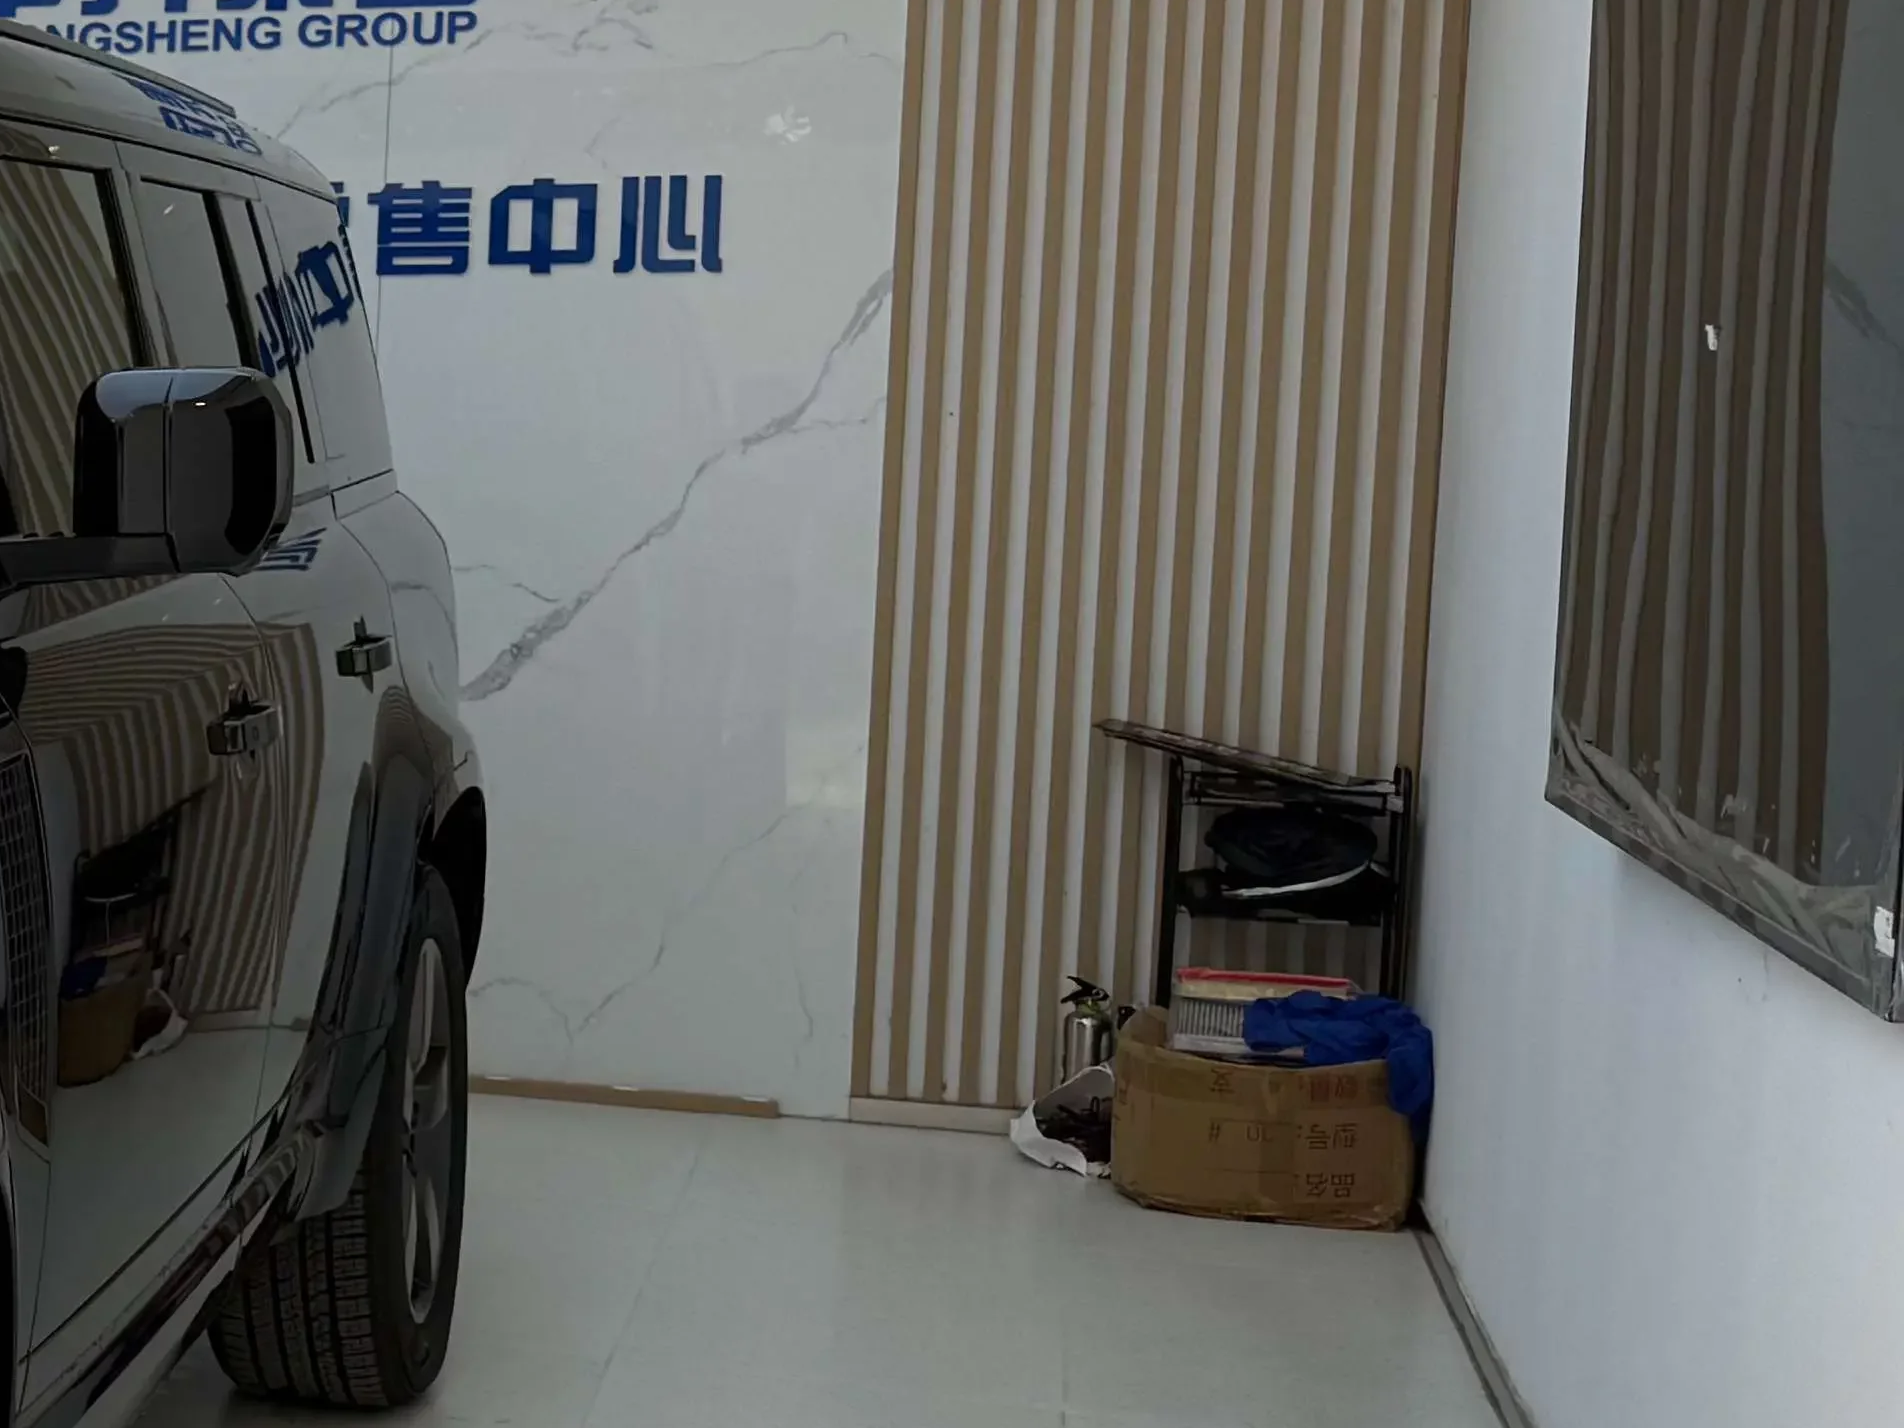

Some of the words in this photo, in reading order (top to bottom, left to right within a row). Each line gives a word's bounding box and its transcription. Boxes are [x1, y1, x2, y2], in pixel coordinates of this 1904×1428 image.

[299, 11, 477, 47] GROUP
[332, 174, 723, 276] 售中心
